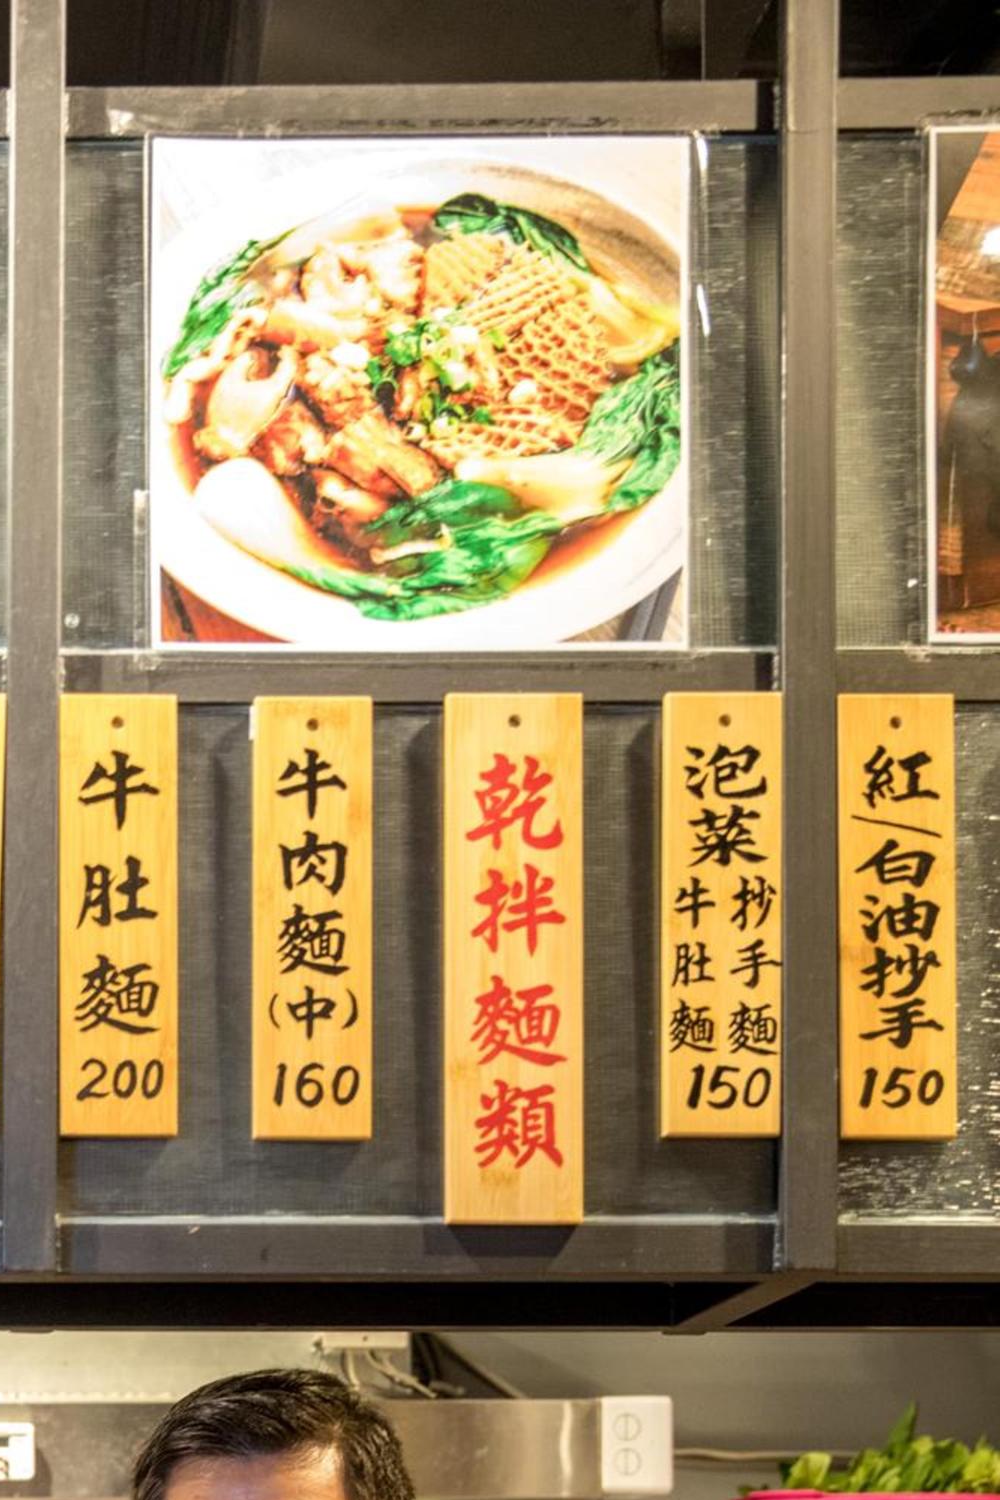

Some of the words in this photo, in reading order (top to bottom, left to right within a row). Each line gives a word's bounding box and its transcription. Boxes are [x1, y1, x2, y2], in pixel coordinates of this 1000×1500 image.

[75, 750, 160, 1035] 牛肚麵
[466, 754, 566, 1169] 乾拌麵類
[670, 877, 716, 1053] 牛肚麵
[76, 1058, 164, 1101] 200
[273, 1062, 360, 1108] 160
[687, 1064, 772, 1110] 150
[859, 1067, 945, 1109] 150
